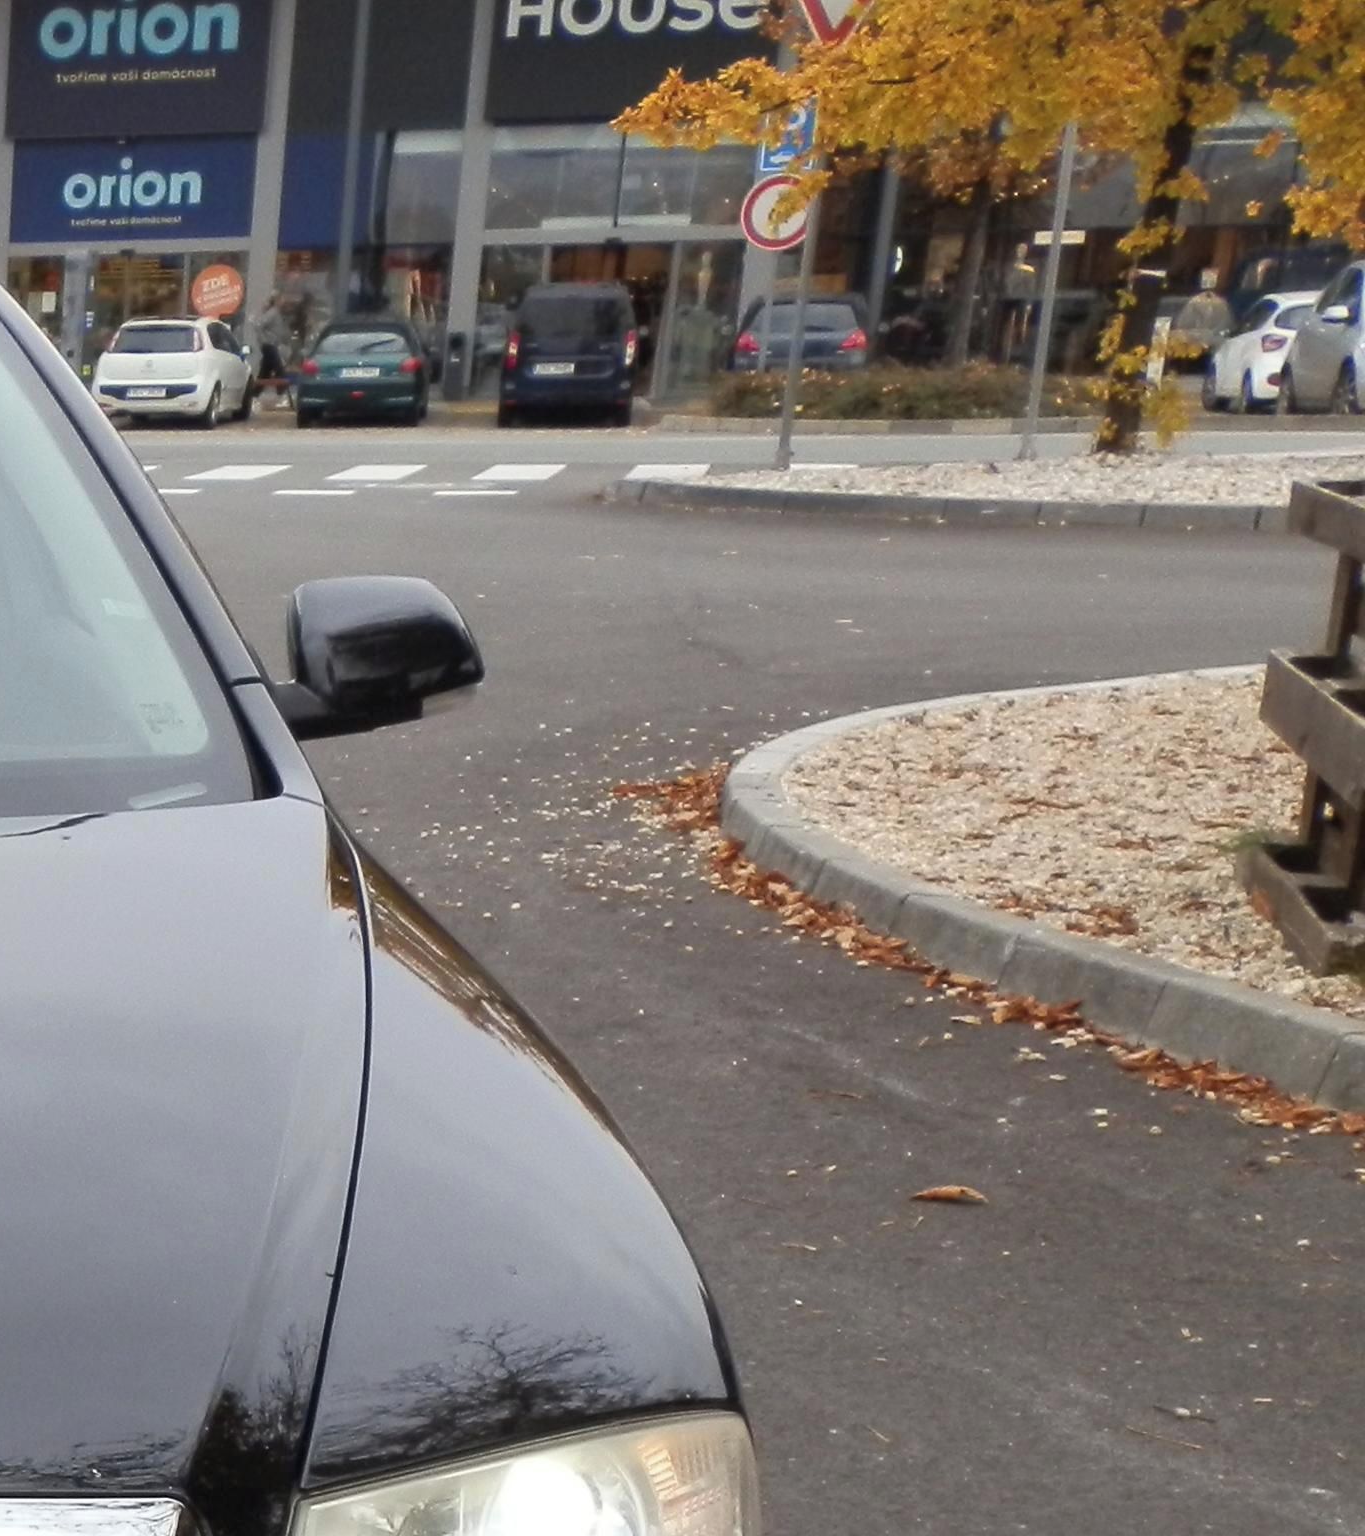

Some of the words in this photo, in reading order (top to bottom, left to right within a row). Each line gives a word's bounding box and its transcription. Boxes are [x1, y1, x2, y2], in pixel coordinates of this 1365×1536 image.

[40, 0, 239, 58] orion
[506, 0, 760, 37] HOUSE
[63, 156, 202, 208] orion
